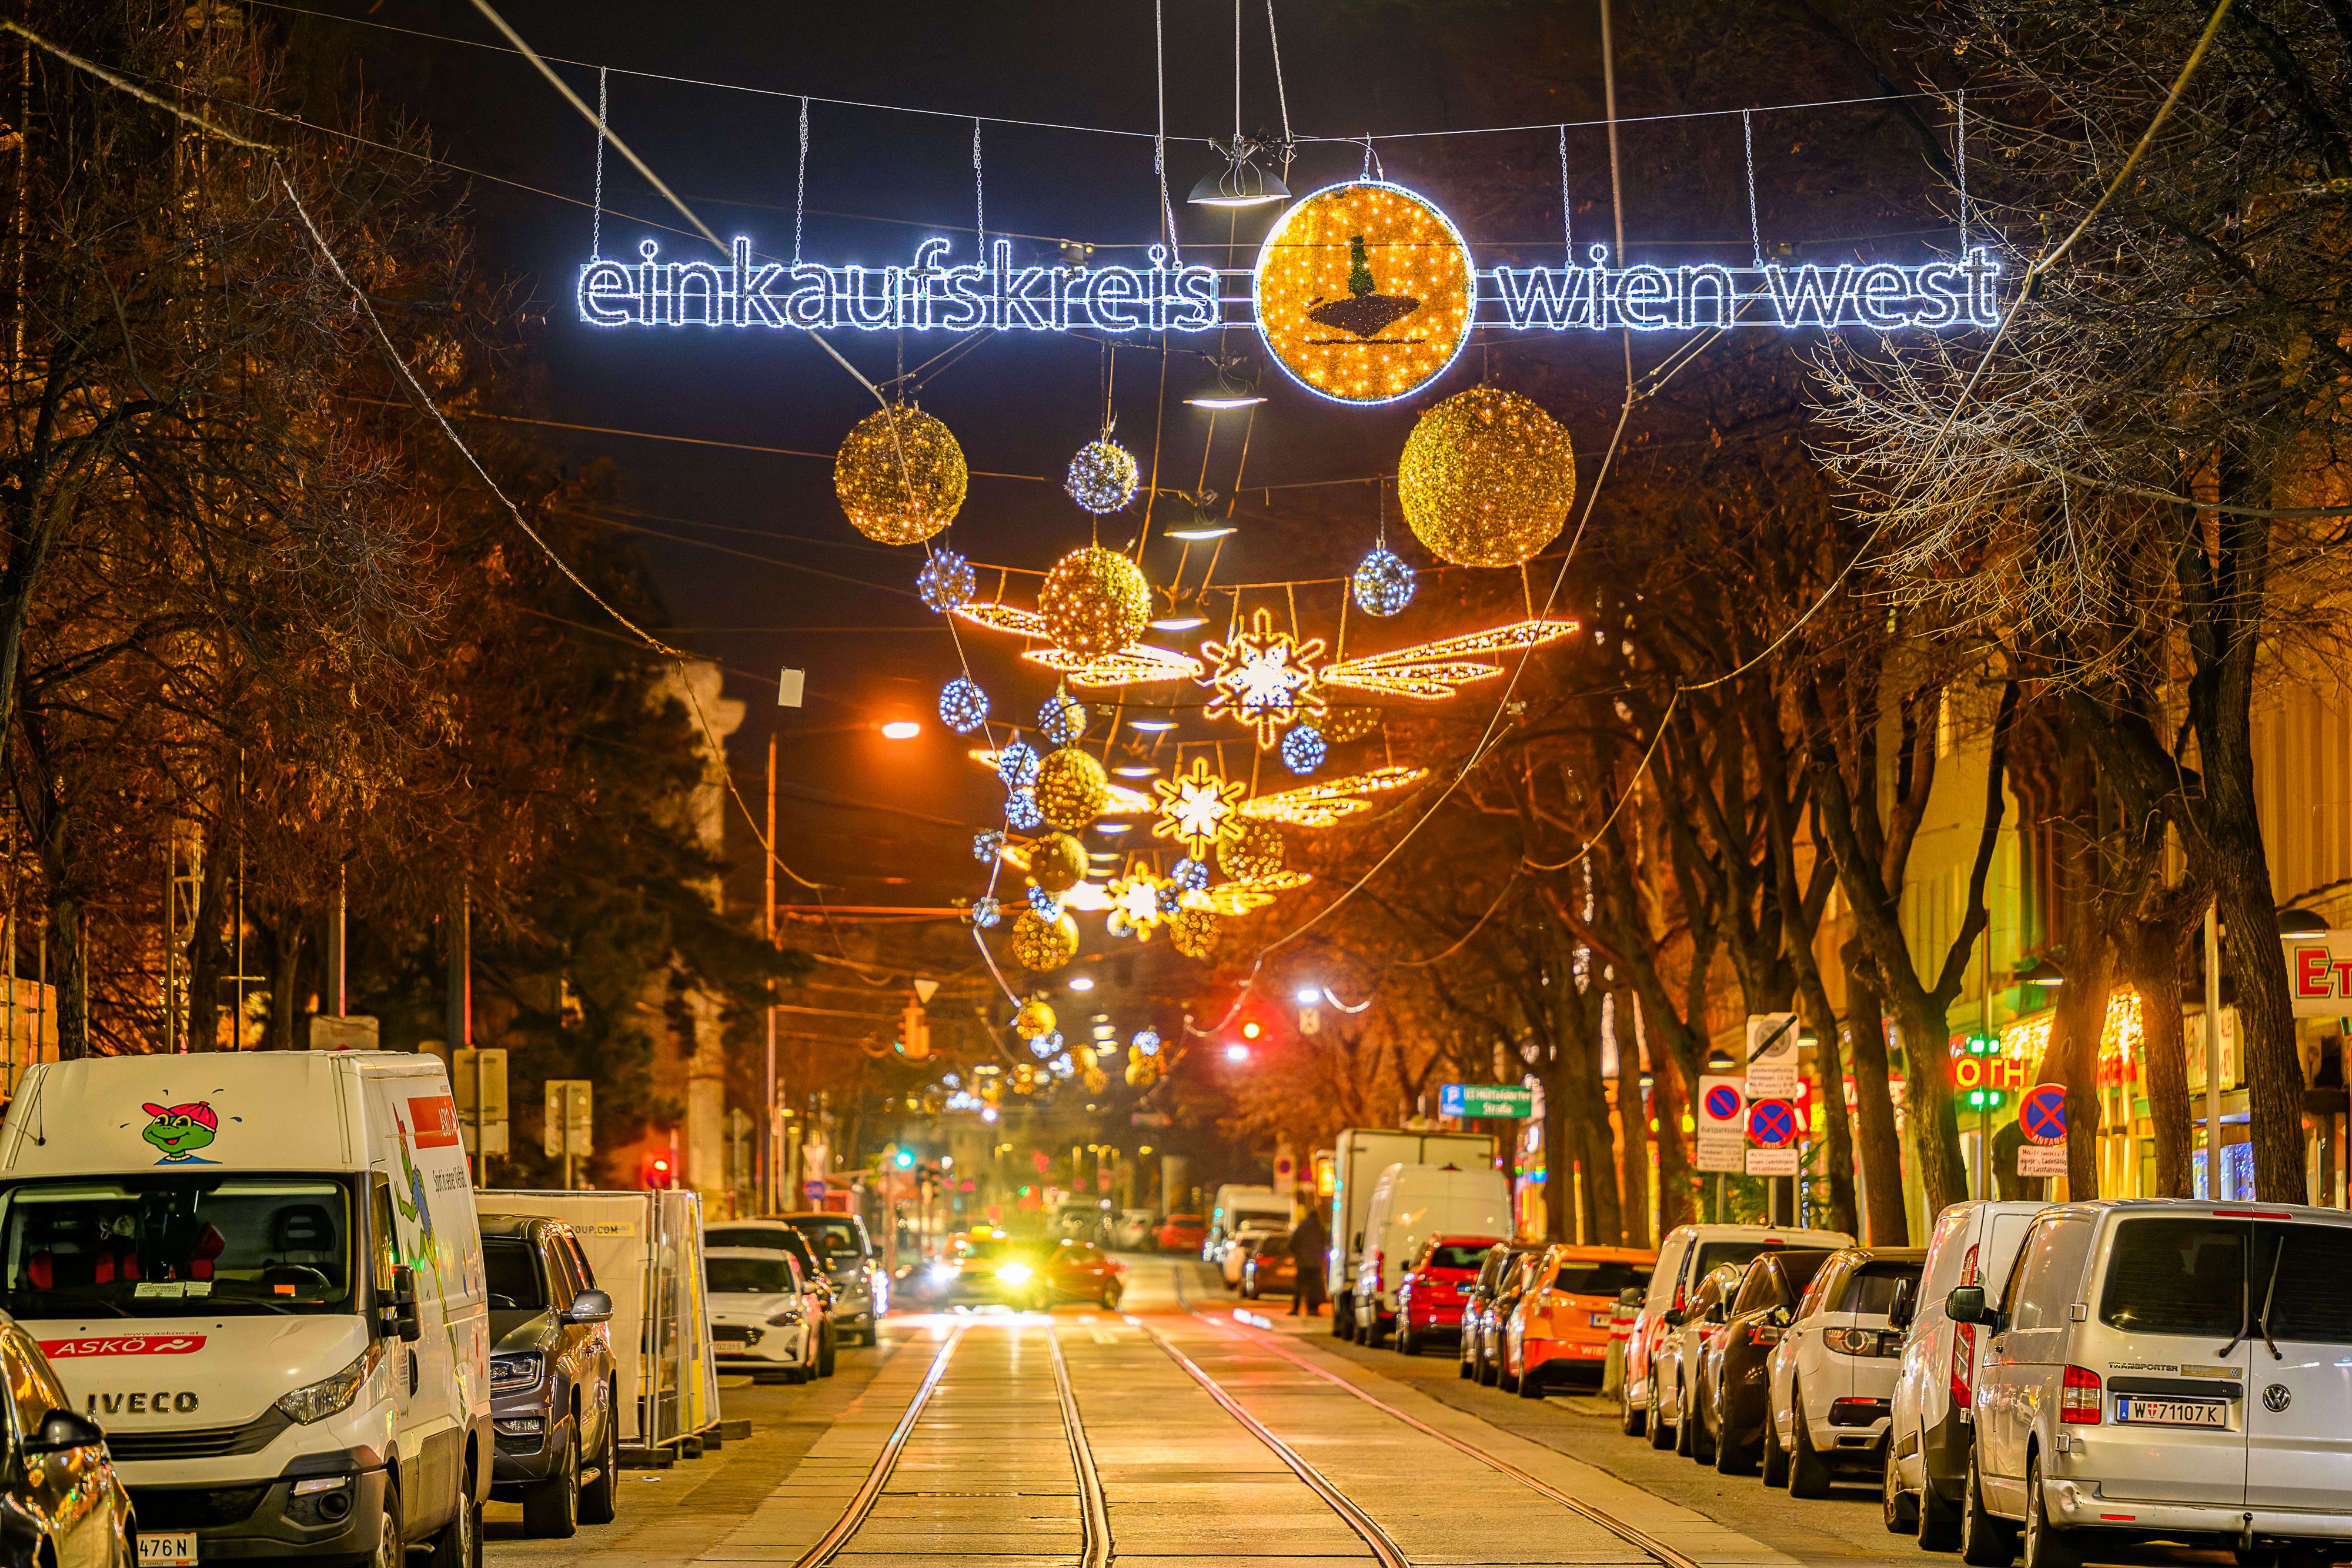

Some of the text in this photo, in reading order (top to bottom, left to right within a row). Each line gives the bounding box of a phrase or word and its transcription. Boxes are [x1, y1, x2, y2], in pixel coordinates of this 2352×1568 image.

[577, 236, 2000, 331] einkaufskreis wien west
[1483, 1102, 1514, 1115] Straße
[2032, 1132, 2066, 1146] ANFANG
[570, 1225, 618, 1234] OUP.COM
[54, 1338, 146, 1355] ASKÖ
[2109, 1362, 2179, 1372] TRANSPORTER
[86, 1391, 199, 1415] IVECO
[2134, 1402, 2146, 1418] W
